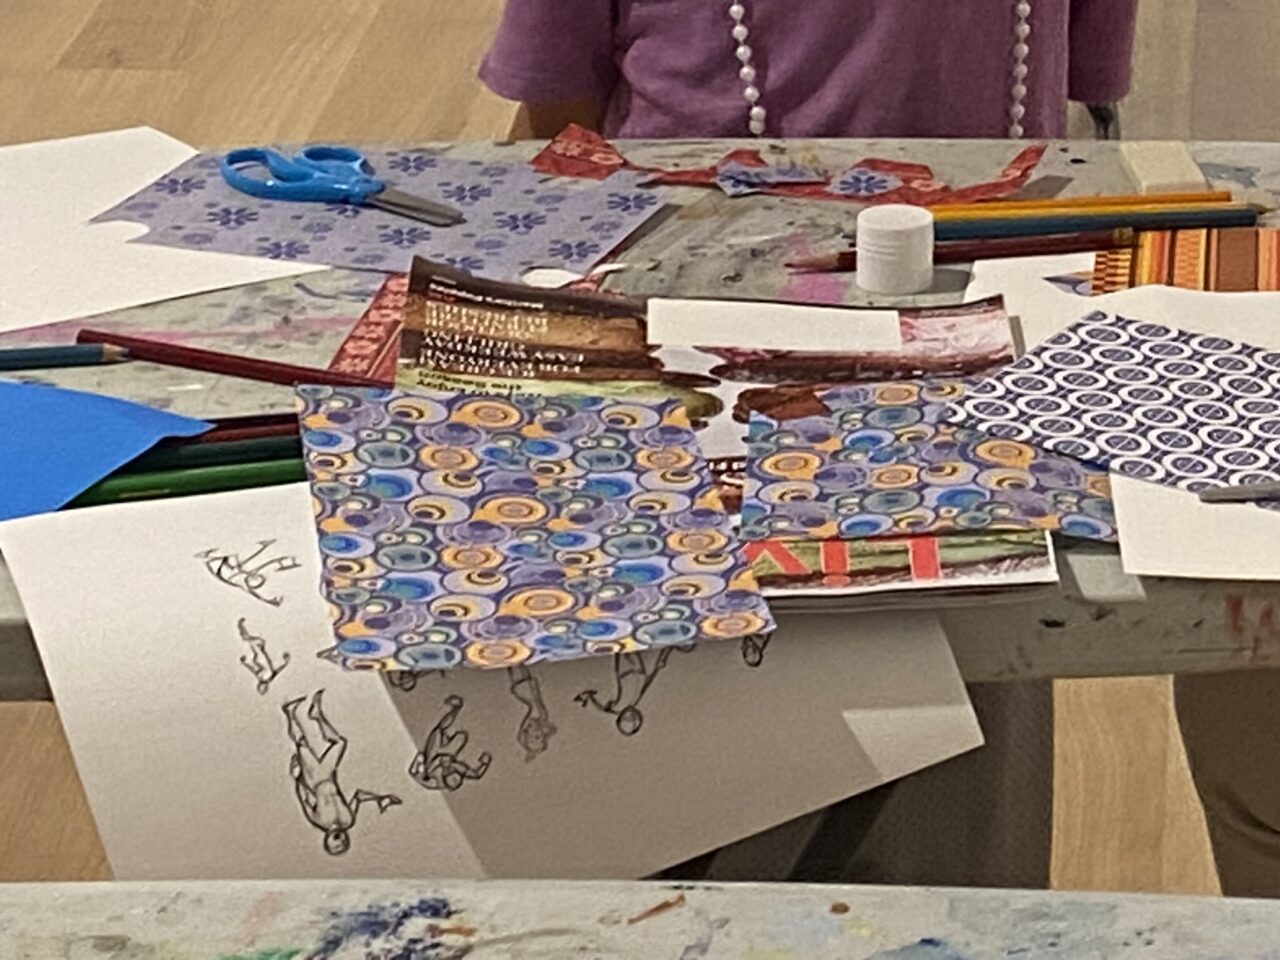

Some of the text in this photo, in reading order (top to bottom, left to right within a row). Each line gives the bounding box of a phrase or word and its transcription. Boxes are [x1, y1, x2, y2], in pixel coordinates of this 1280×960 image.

[424, 336, 527, 359] WEEKDAY
[421, 348, 581, 374] FOR EVERYONE
[743, 536, 941, 585] Liv
